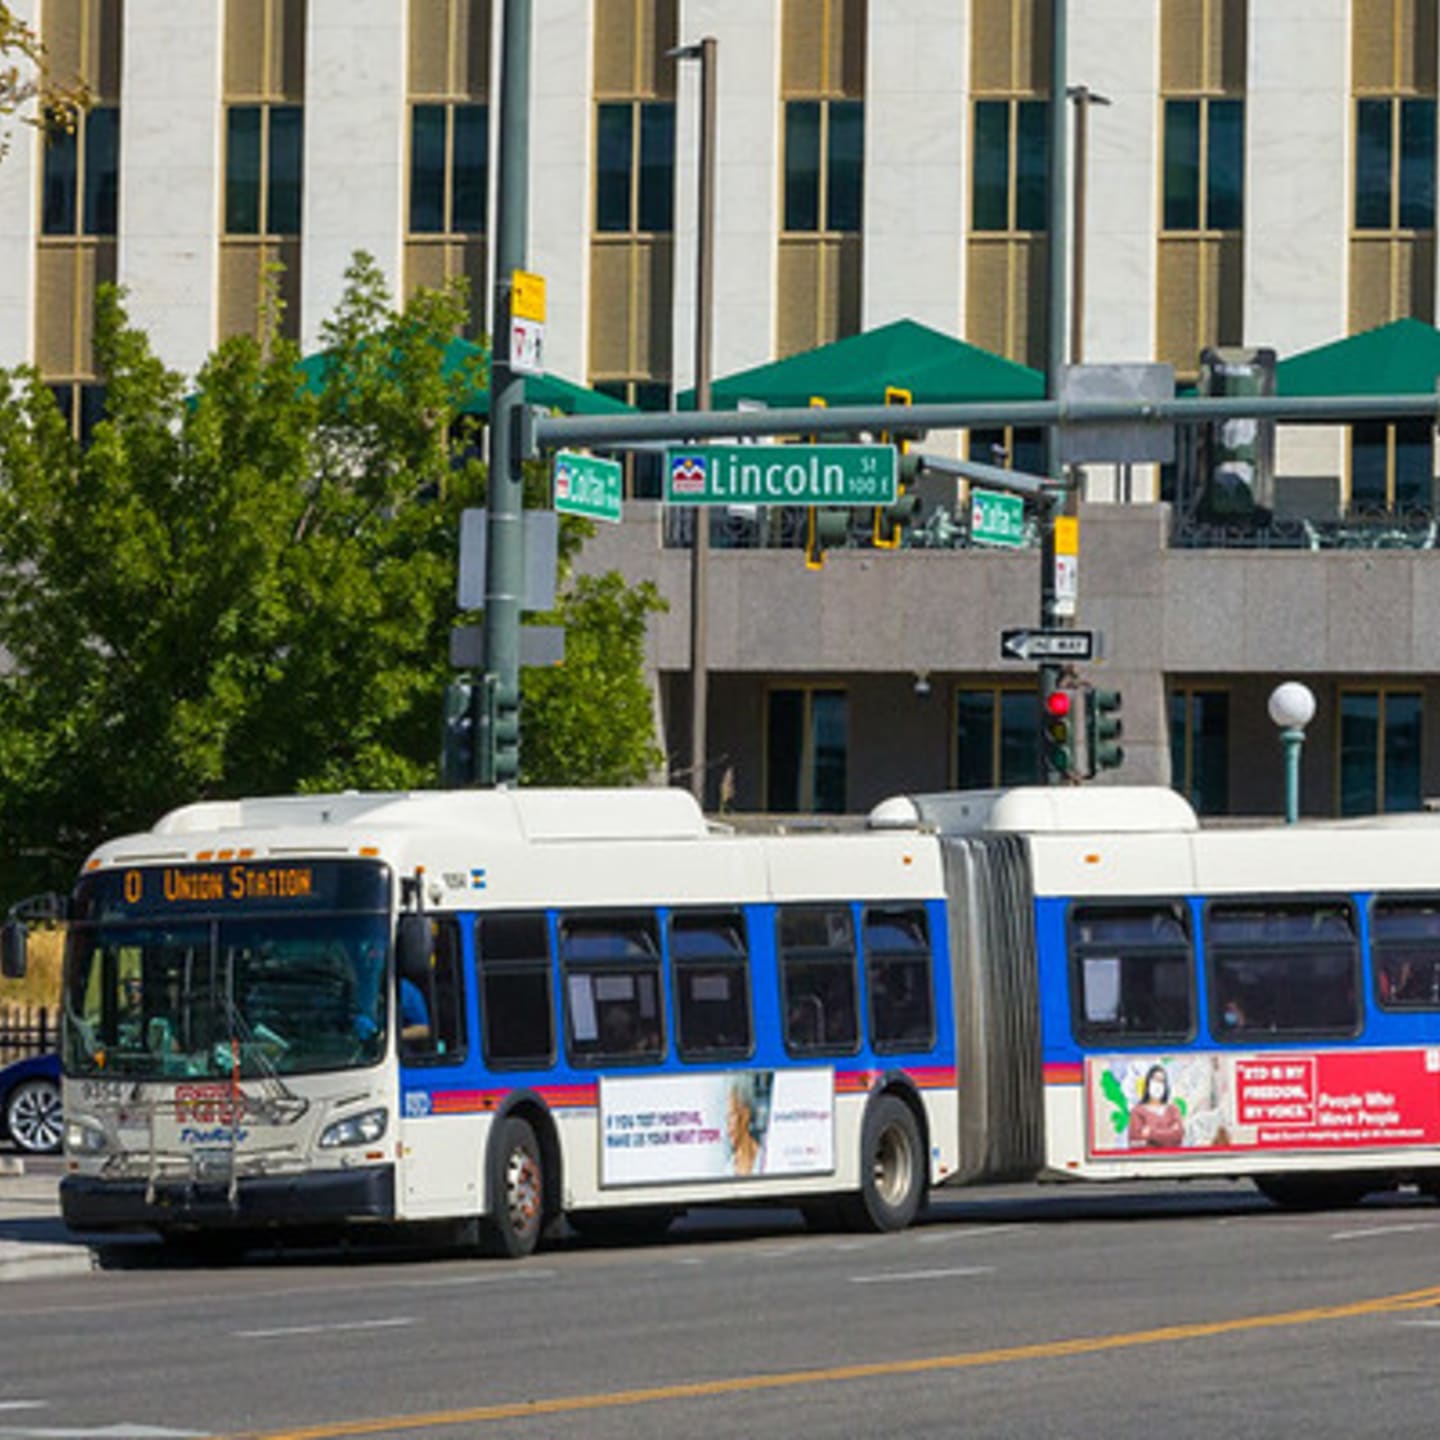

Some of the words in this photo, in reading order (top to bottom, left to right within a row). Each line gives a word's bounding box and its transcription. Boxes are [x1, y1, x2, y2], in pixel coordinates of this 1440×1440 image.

[860, 457, 876, 473] St
[711, 455, 844, 496] Lincoln
[849, 476, 876, 495] 100
[163, 868, 224, 901] UNION
[229, 865, 312, 899] STATION
[1320, 1092, 1363, 1110] People
[1365, 1091, 1396, 1107] Who
[1320, 1111, 1354, 1125] Move
[1357, 1109, 1400, 1126] People
